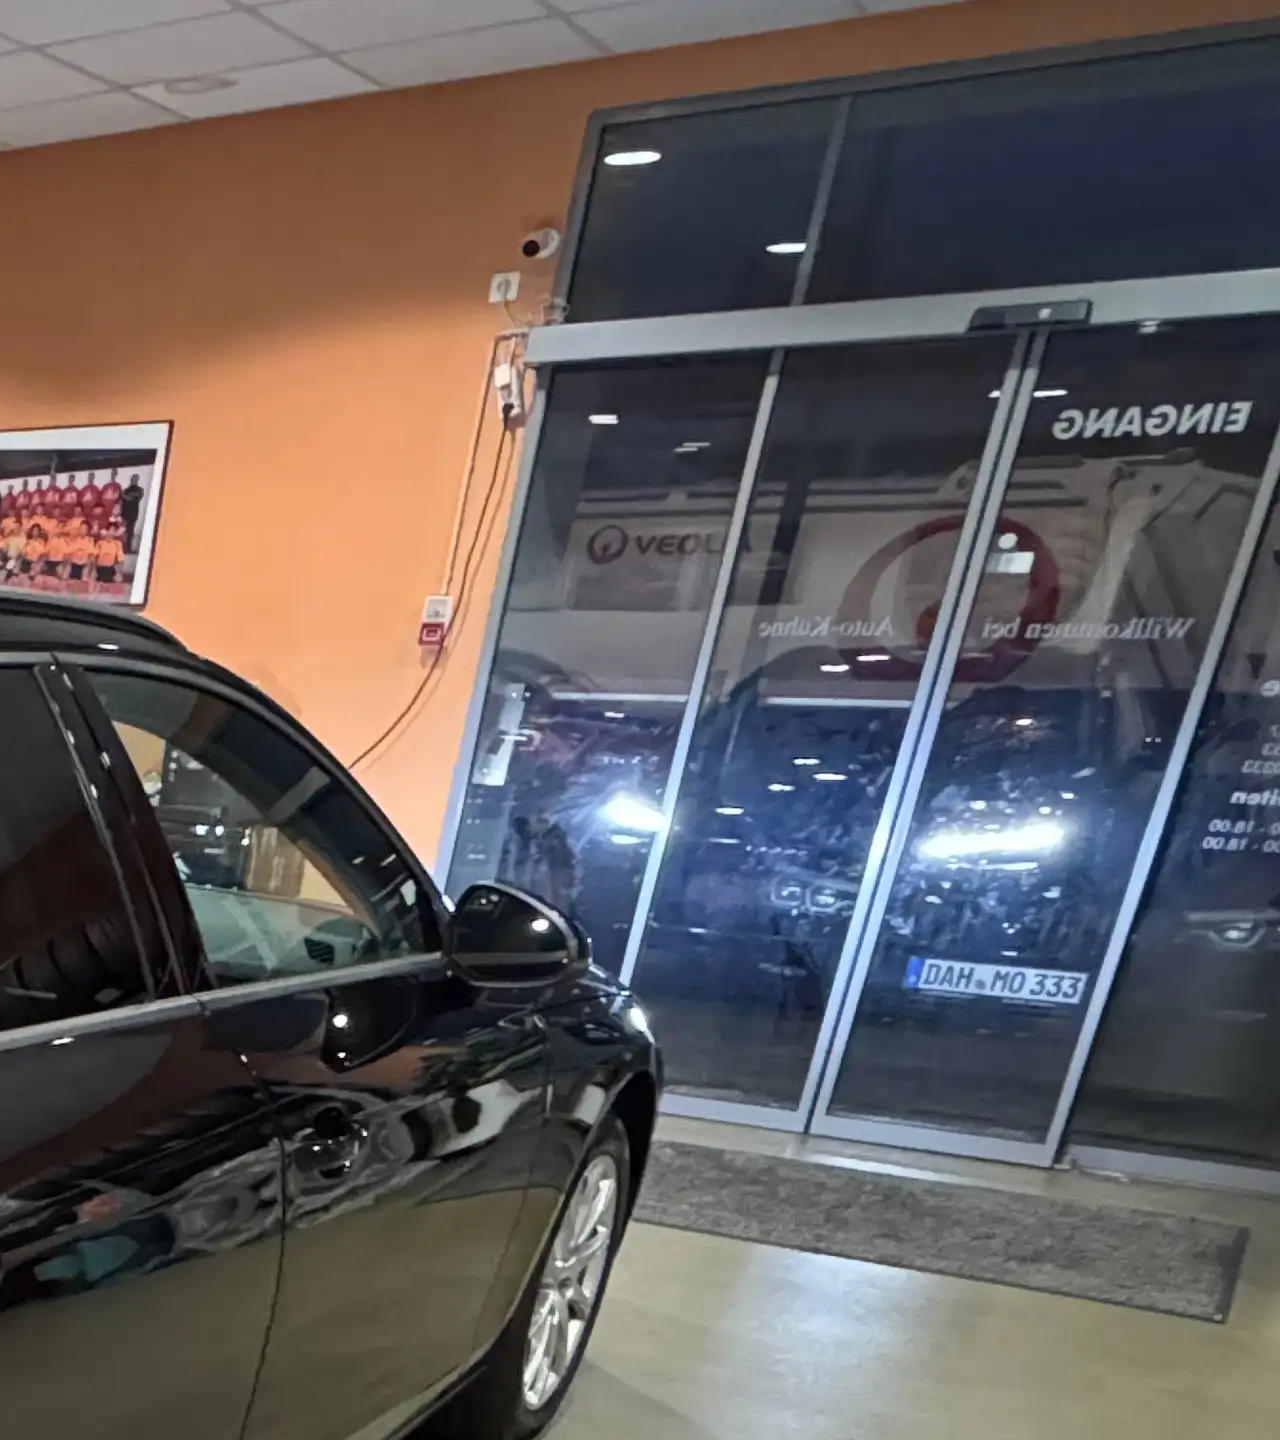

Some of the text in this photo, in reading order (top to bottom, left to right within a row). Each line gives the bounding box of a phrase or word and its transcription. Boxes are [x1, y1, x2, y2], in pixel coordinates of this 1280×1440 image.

[923, 963, 1083, 999] DAH MO 333
